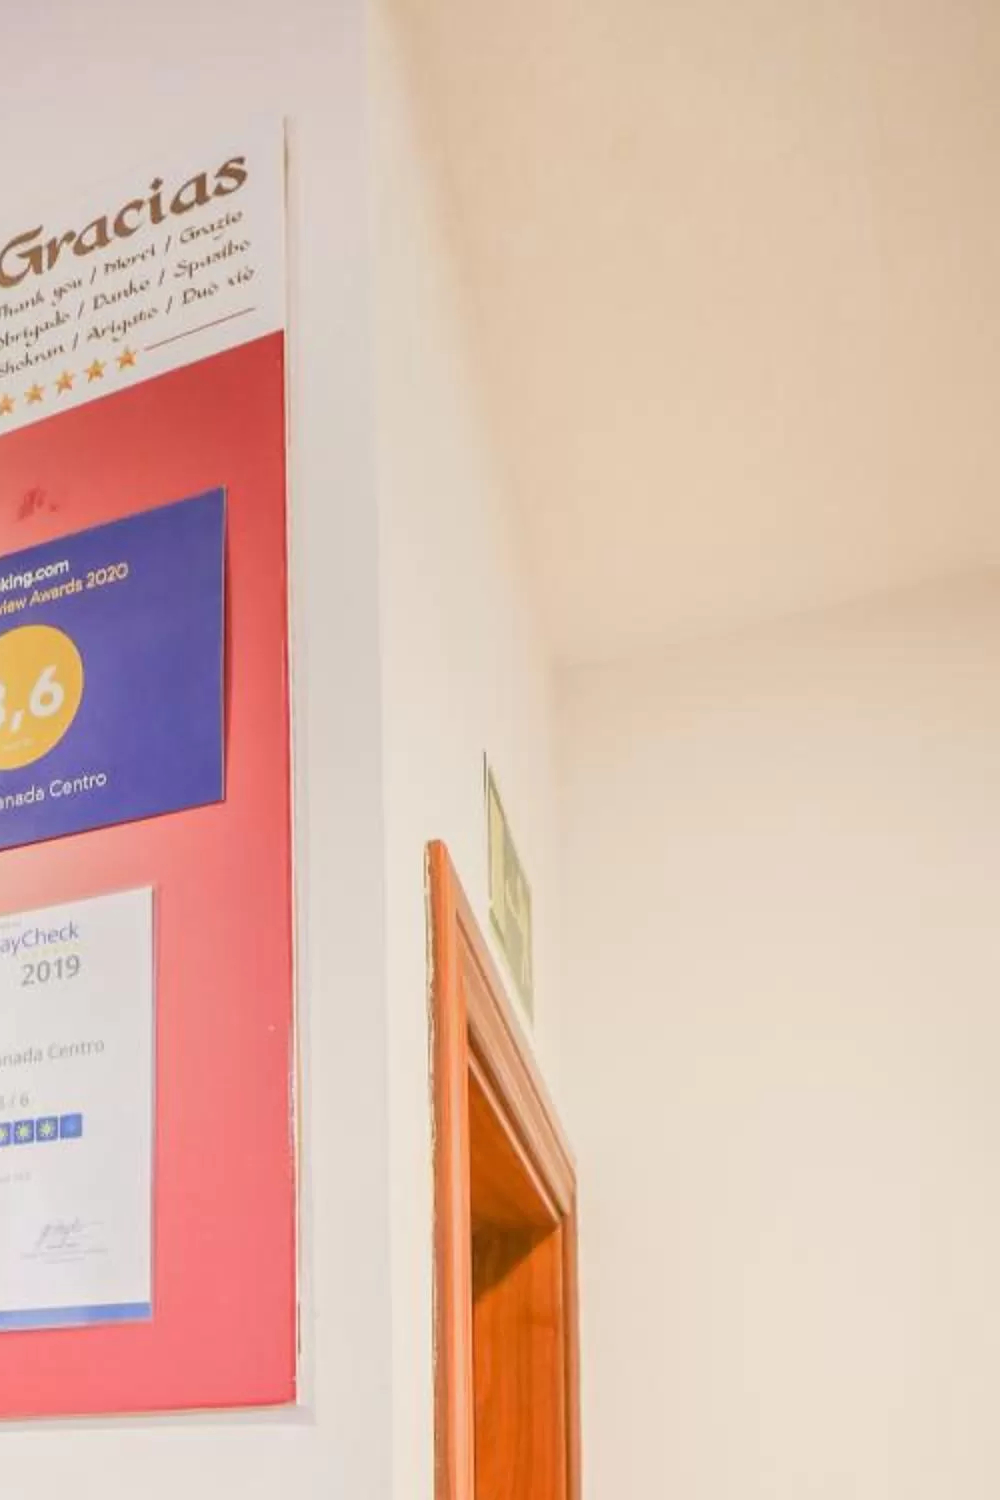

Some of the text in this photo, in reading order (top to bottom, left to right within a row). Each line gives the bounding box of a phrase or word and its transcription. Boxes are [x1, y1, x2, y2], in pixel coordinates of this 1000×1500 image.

[51, 277, 83, 307] you
[30, 579, 83, 607] Awards
[86, 561, 129, 589] 2020
[49, 772, 107, 798] Centro
[20, 953, 81, 988] 2019
[47, 1038, 106, 1061] Centro
